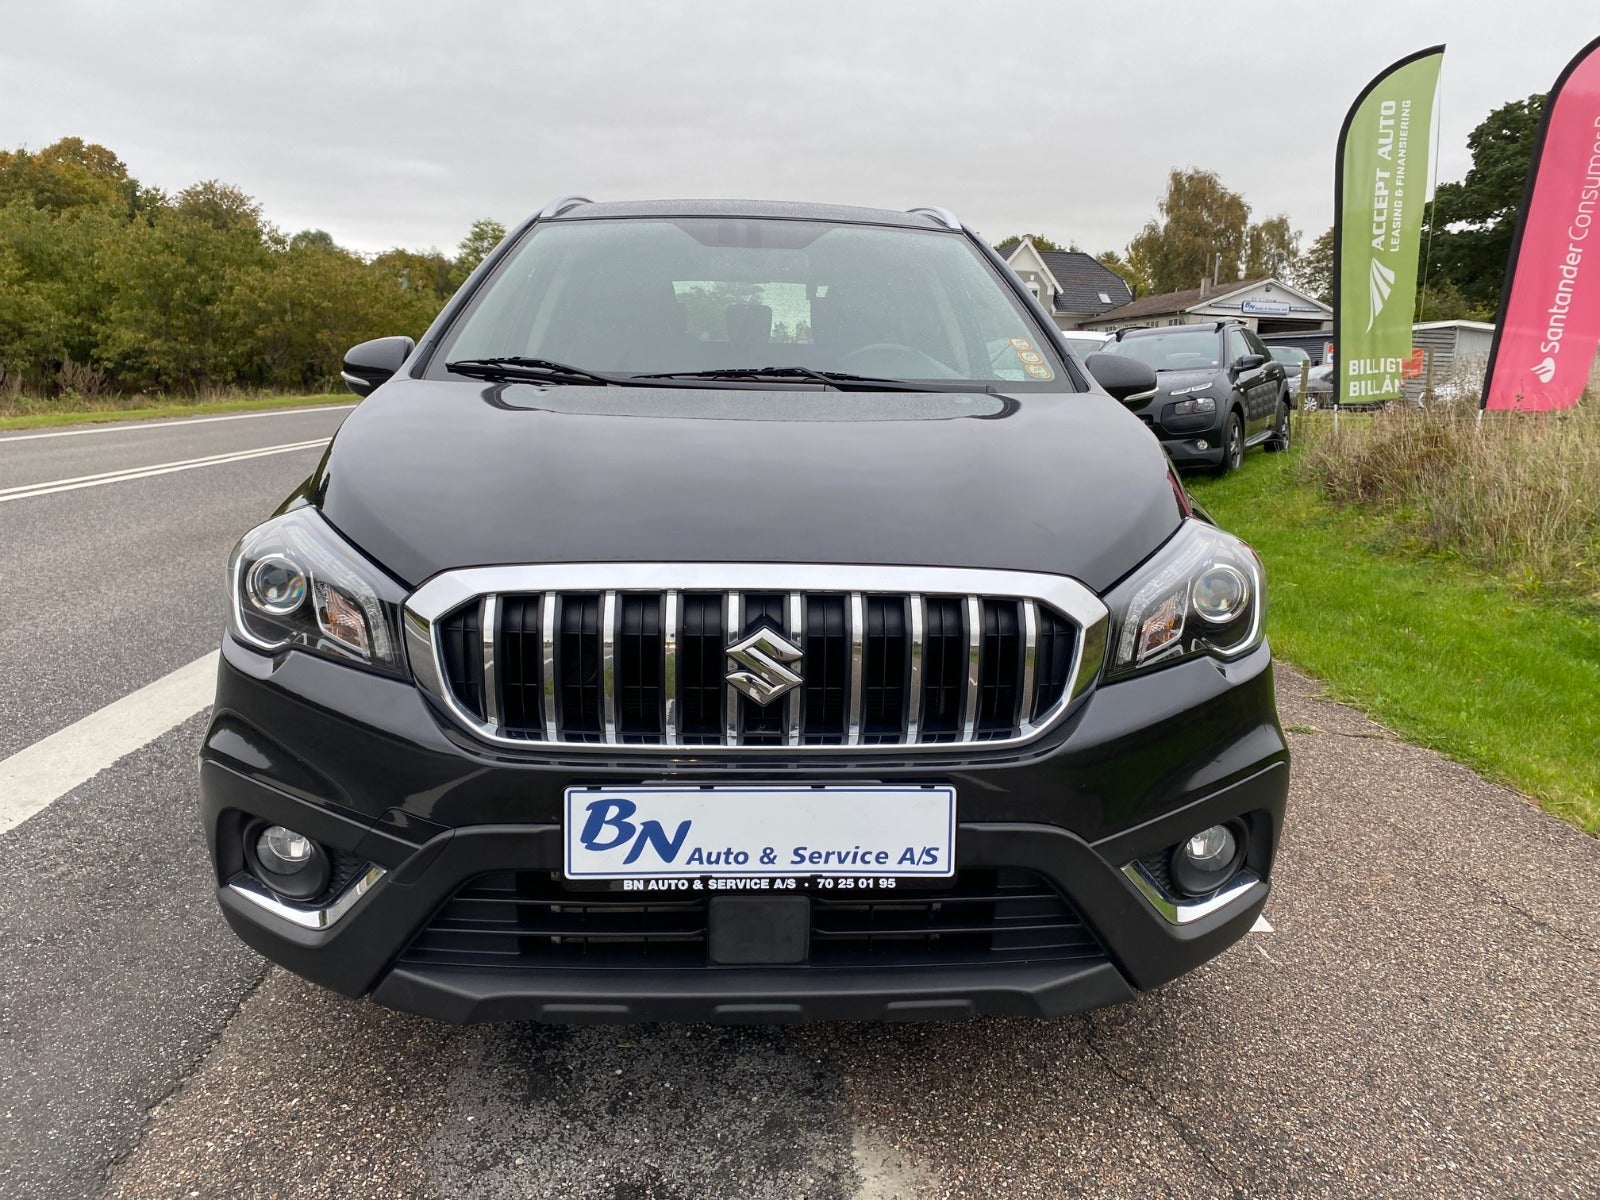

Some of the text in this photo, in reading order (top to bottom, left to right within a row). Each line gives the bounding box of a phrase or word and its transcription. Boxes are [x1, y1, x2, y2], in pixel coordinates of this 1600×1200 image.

[1372, 100, 1396, 251] ACCEPT AUTO
[1390, 100, 1411, 252] LEASING & FINANSIERING
[1540, 131, 1600, 354] Santander Consum
[1348, 357, 1403, 376] BILLIGT
[580, 798, 940, 866] BN Auto & Service A/S
[623, 878, 896, 891] BN AUTO & SERVICE A/S 70 25 01 95
